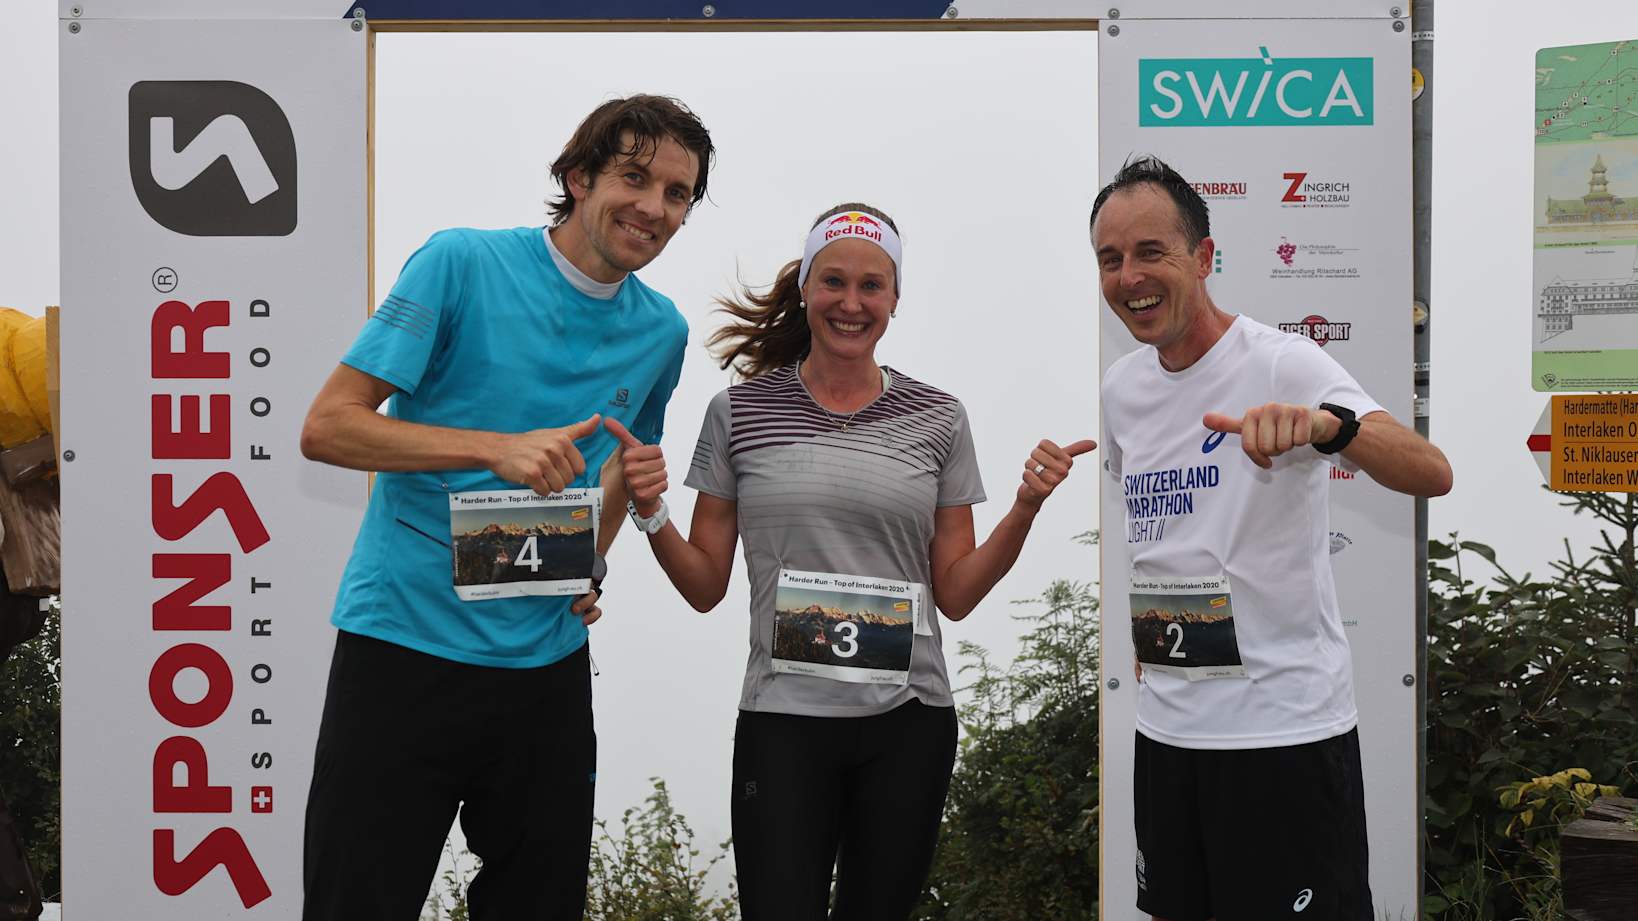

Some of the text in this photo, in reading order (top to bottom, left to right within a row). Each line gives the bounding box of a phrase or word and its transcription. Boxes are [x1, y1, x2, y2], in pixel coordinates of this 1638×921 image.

[1281, 172, 1350, 202] ZINGRICH
[1309, 194, 1350, 202] HOLZBAU
[825, 225, 882, 242] Red Bull
[1313, 323, 1350, 340] SPORT
[1564, 399, 1618, 415] Hardermatte
[1563, 421, 1624, 438] Interlaken
[1563, 446, 1579, 462] St.
[1124, 465, 1219, 496] SWITZERLAND
[1563, 468, 1624, 485] Interlaken
[461, 496, 486, 505] Harder
[488, 496, 502, 504] Run
[508, 495, 522, 504] Top
[522, 494, 530, 502] of
[564, 493, 582, 501] 2020
[1126, 491, 1193, 519] MARATHON
[249, 298, 273, 769] SPORT FOOD
[514, 536, 543, 573] 4
[788, 575, 813, 584] Harder
[834, 580, 847, 588] Top
[855, 581, 888, 592] Interlaken
[888, 585, 905, 593] 2020
[1173, 582, 1202, 590] Interlaken
[149, 300, 272, 910] SPONSER
[831, 620, 859, 658] 3
[1166, 622, 1187, 659] 2
